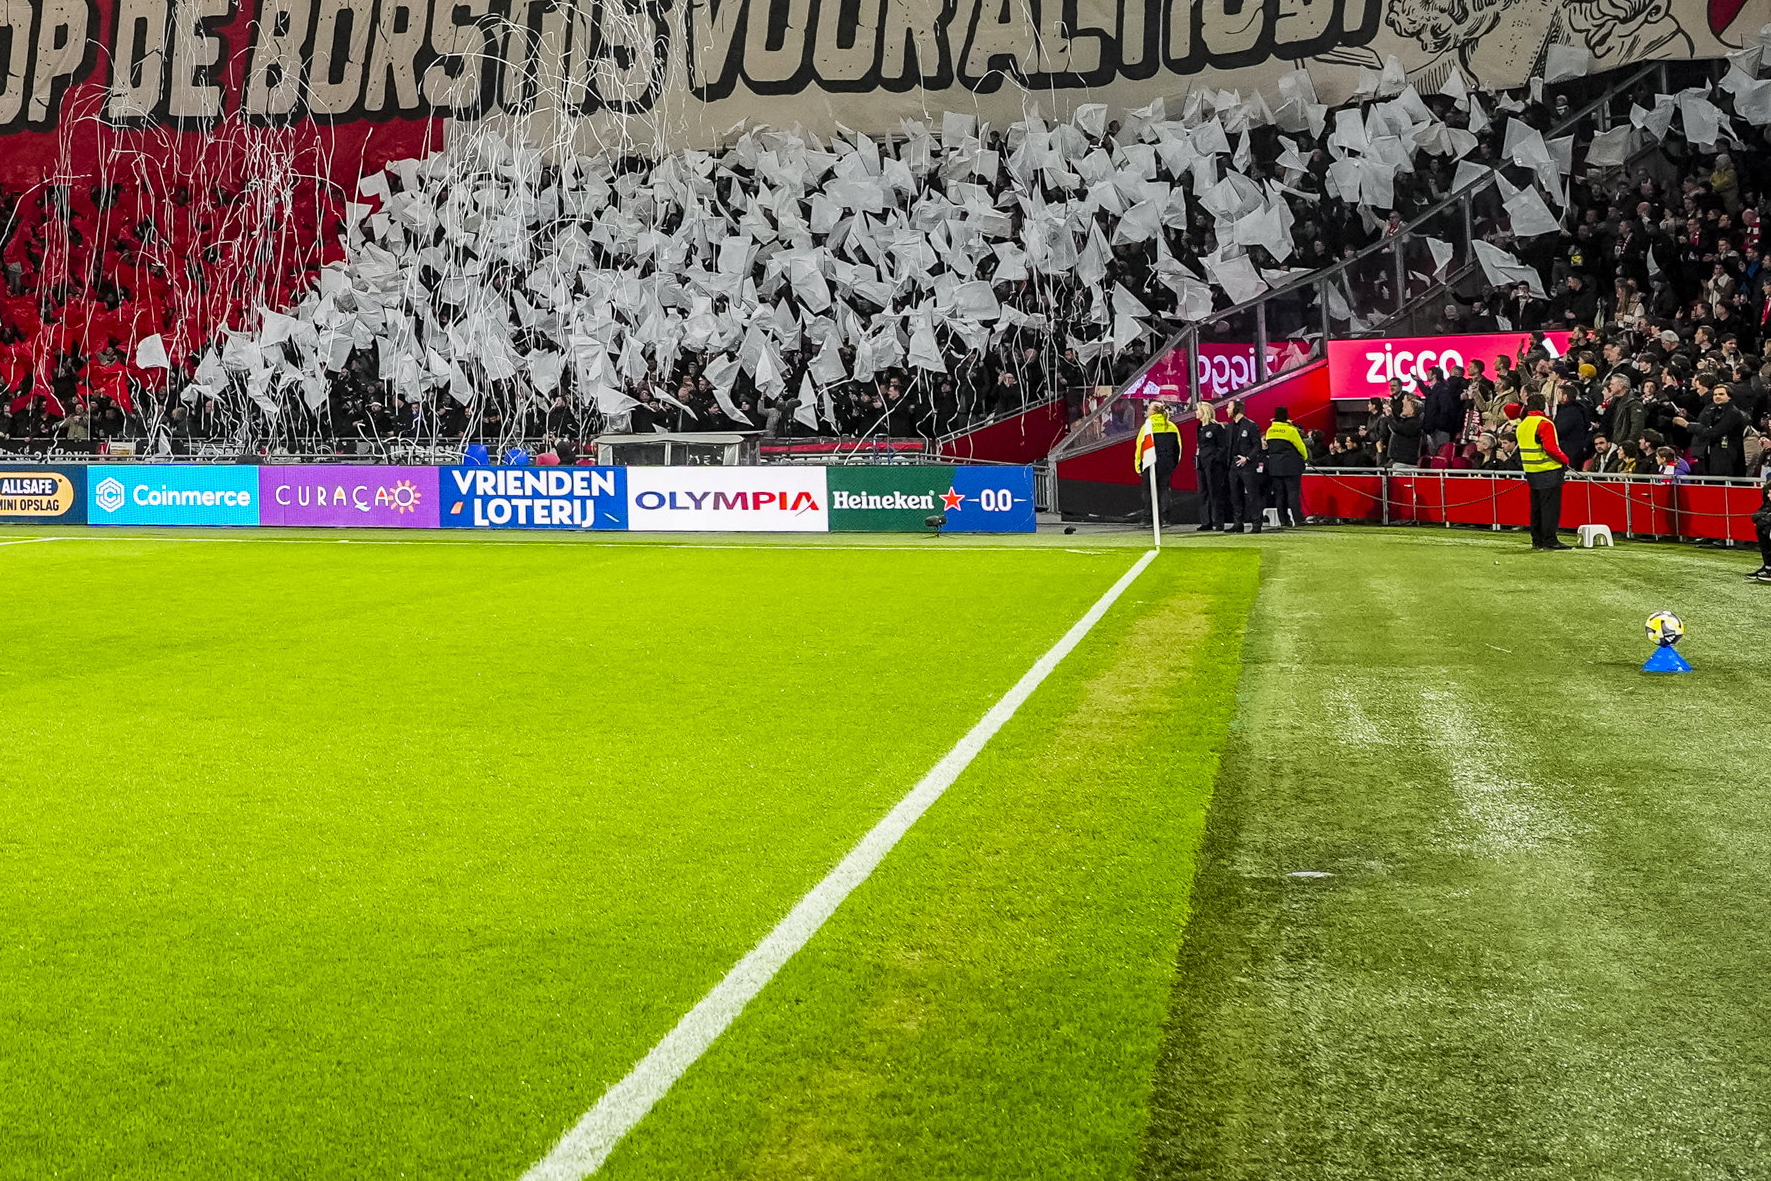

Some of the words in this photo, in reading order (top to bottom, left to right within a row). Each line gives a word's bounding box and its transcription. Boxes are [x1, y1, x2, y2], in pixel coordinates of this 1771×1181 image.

[1, 479, 53, 494] ALLSAFE
[132, 484, 251, 507] Coinmerce
[452, 470, 615, 498] VRIENDEN
[19, 499, 59, 511] OPSLAG
[276, 484, 415, 512] CURAÇAO
[635, 491, 820, 515] OLYMPIA
[832, 490, 934, 510] Heineken
[980, 488, 1013, 512] 0.0
[474, 498, 595, 527] LOTERIJ
